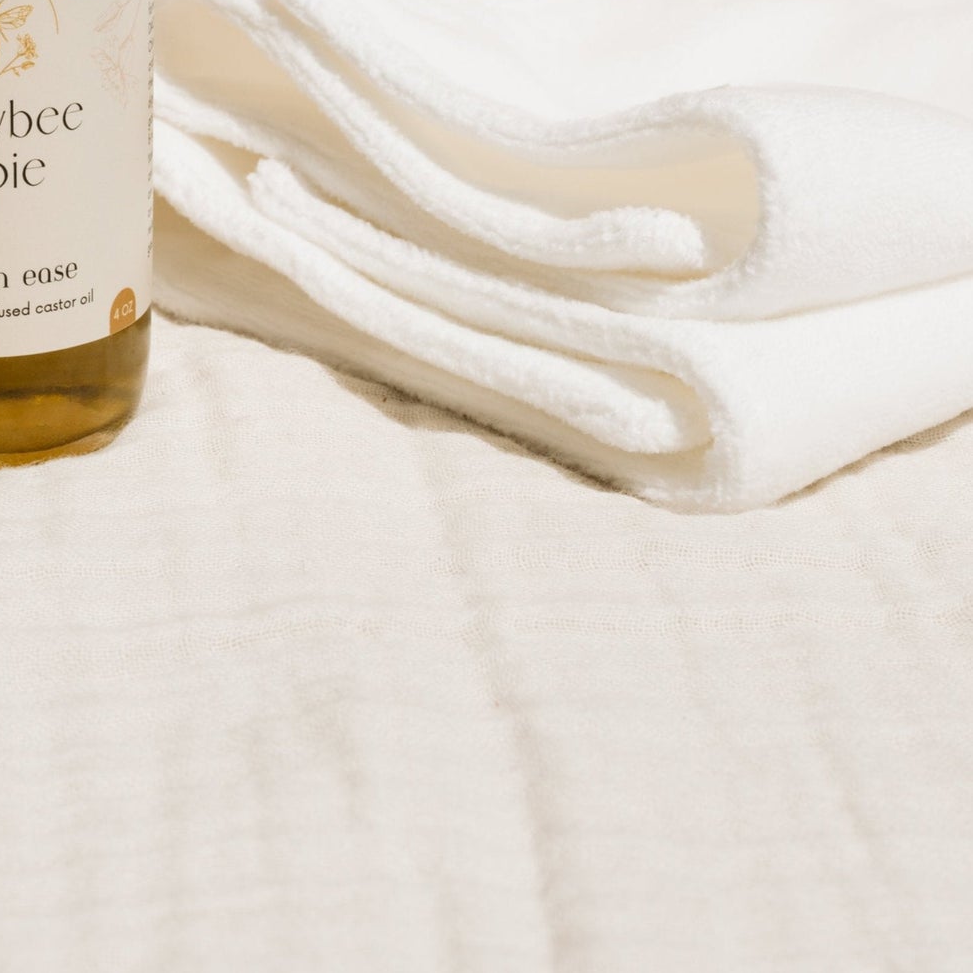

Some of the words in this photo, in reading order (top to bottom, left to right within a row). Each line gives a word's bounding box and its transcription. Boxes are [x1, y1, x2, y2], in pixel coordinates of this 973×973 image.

[21, 260, 79, 285] ease
[35, 296, 77, 315] castor
[80, 289, 95, 306] oil
[113, 307, 120, 320] 4
